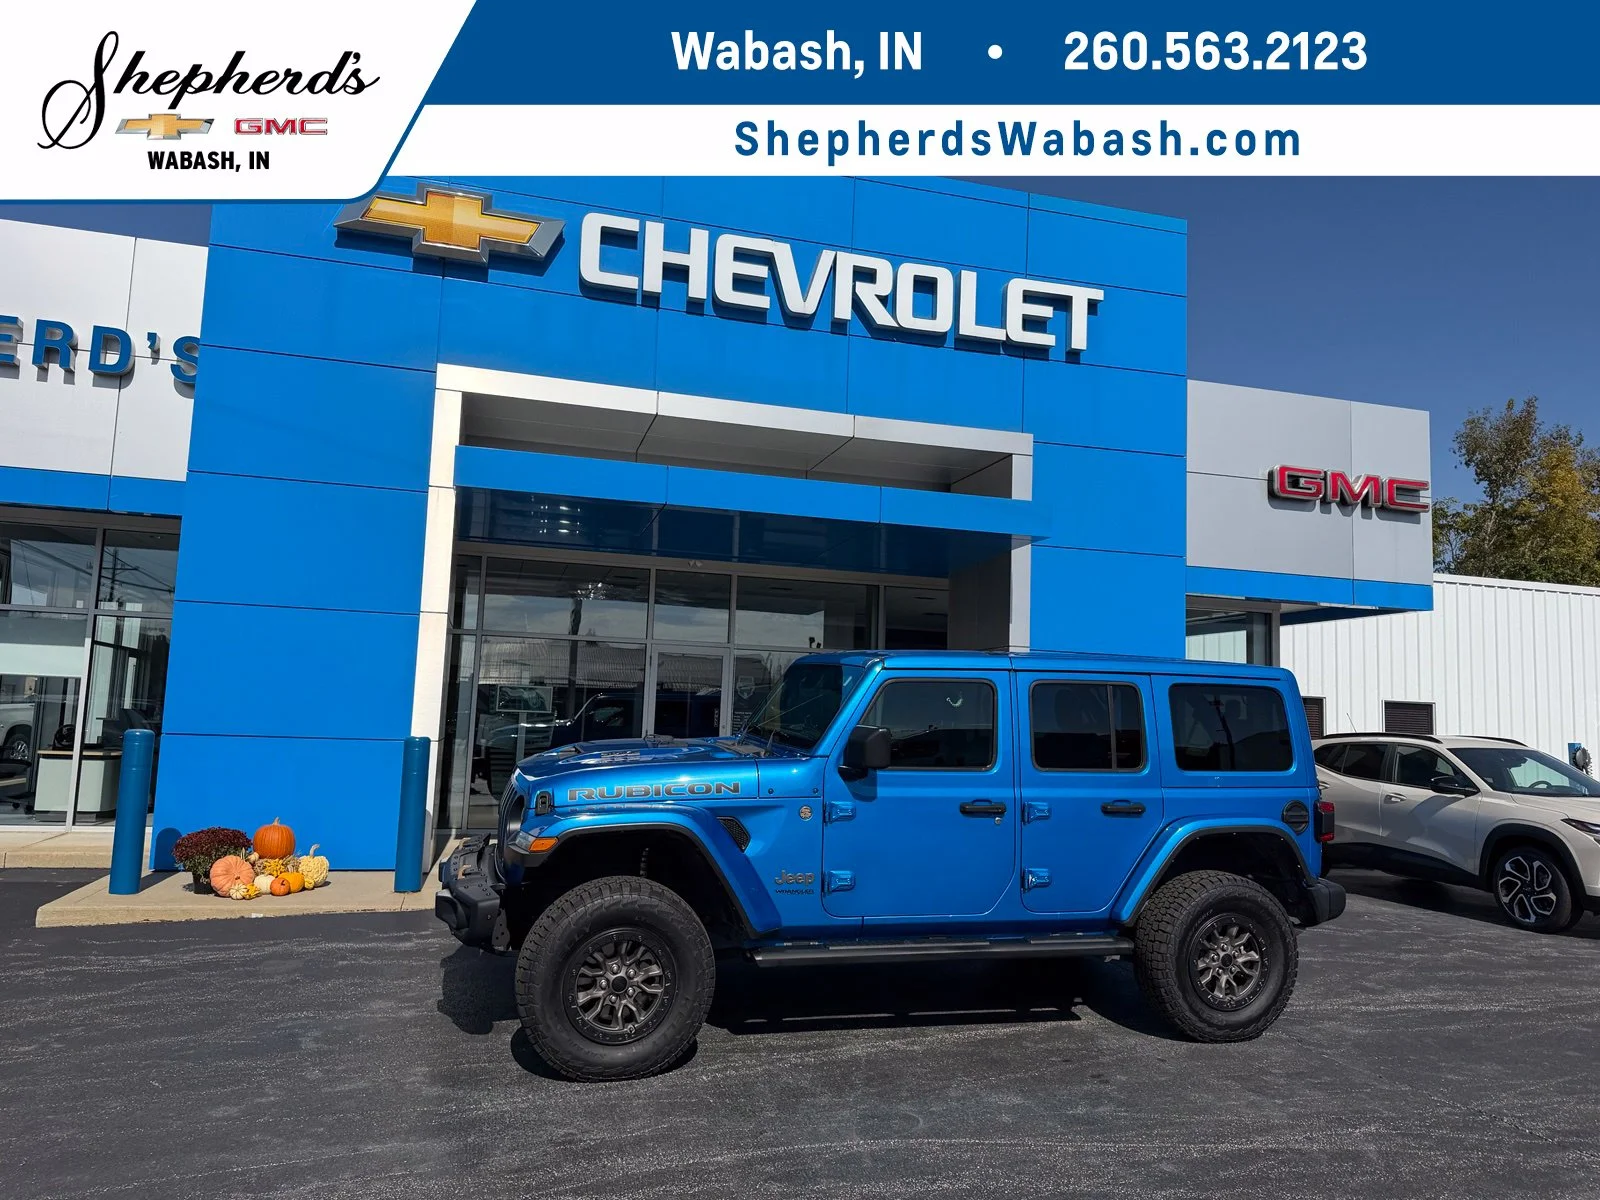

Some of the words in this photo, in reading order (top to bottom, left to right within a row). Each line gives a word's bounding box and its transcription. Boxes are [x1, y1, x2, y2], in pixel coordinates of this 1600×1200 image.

[579, 211, 1104, 353] CHEVROLET
[1271, 464, 1431, 513] GMC
[568, 782, 741, 801] RUBICON
[774, 869, 815, 886] Jeep
